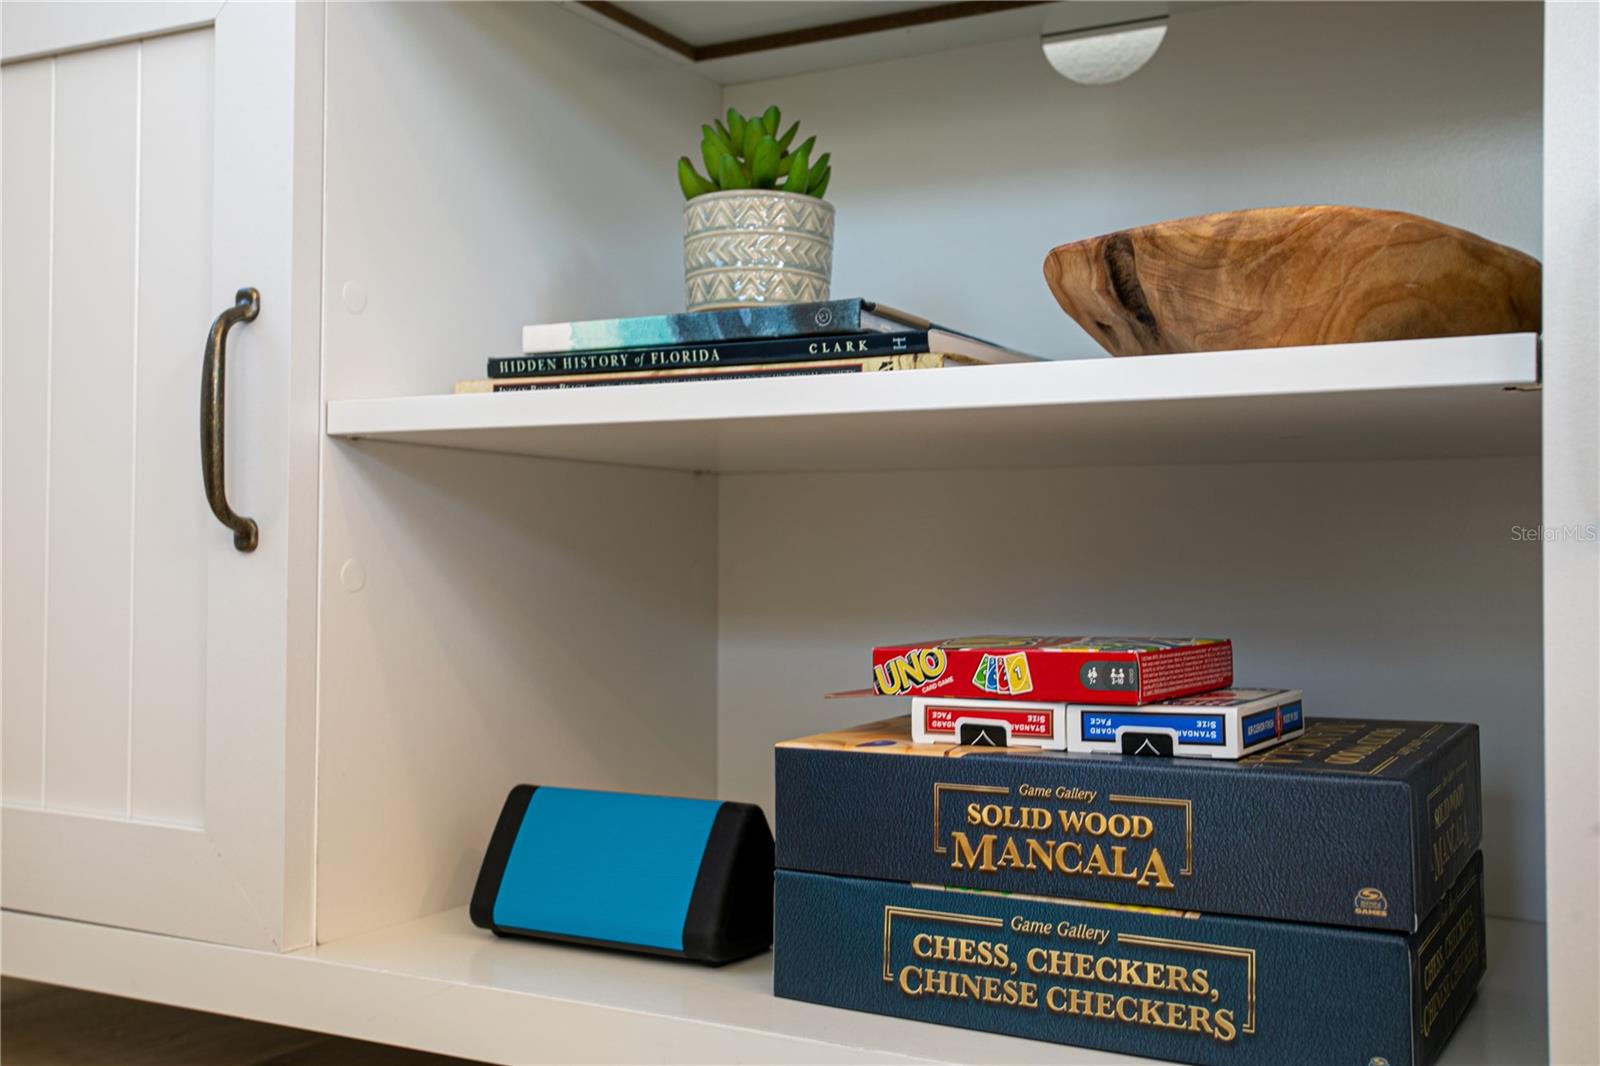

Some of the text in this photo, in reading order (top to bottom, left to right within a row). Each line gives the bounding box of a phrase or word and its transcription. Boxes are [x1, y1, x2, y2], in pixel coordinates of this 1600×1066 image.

[499, 340, 868, 374] HIDDEN HISTORY of FLORIDA CLARK
[873, 648, 948, 696] UNO
[921, 675, 954, 694] CARD GAME
[932, 711, 952, 720] FACE
[1027, 715, 1046, 724] SIZE
[1090, 717, 1112, 727] FACE
[1196, 720, 1217, 729] SIZE
[1019, 783, 1097, 804] Game Gallery
[966, 803, 1154, 838] SOLID WOOD
[951, 831, 1174, 888] MANCALA
[1010, 915, 1110, 944] Game Gallery
[912, 933, 1220, 1002] CHESS, CHECKERS,
[899, 965, 1237, 1041] CHINESE CHECKERS
